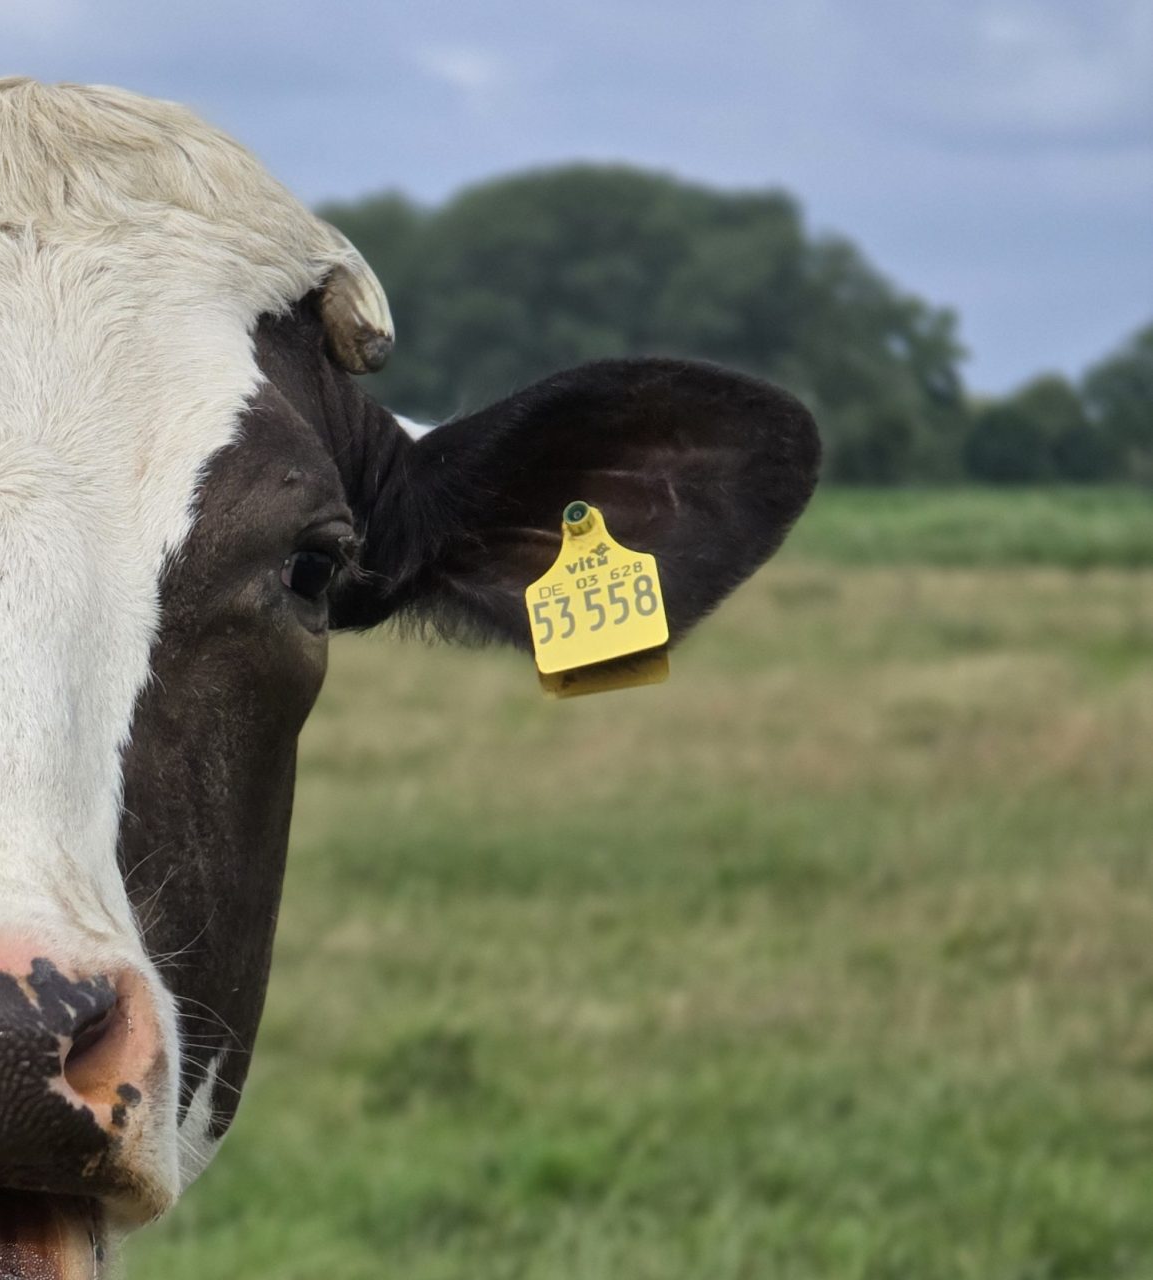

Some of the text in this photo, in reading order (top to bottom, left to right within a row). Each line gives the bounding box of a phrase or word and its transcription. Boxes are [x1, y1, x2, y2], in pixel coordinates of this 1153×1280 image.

[539, 561, 643, 599] DE 03 628
[533, 574, 658, 645] 53 558
